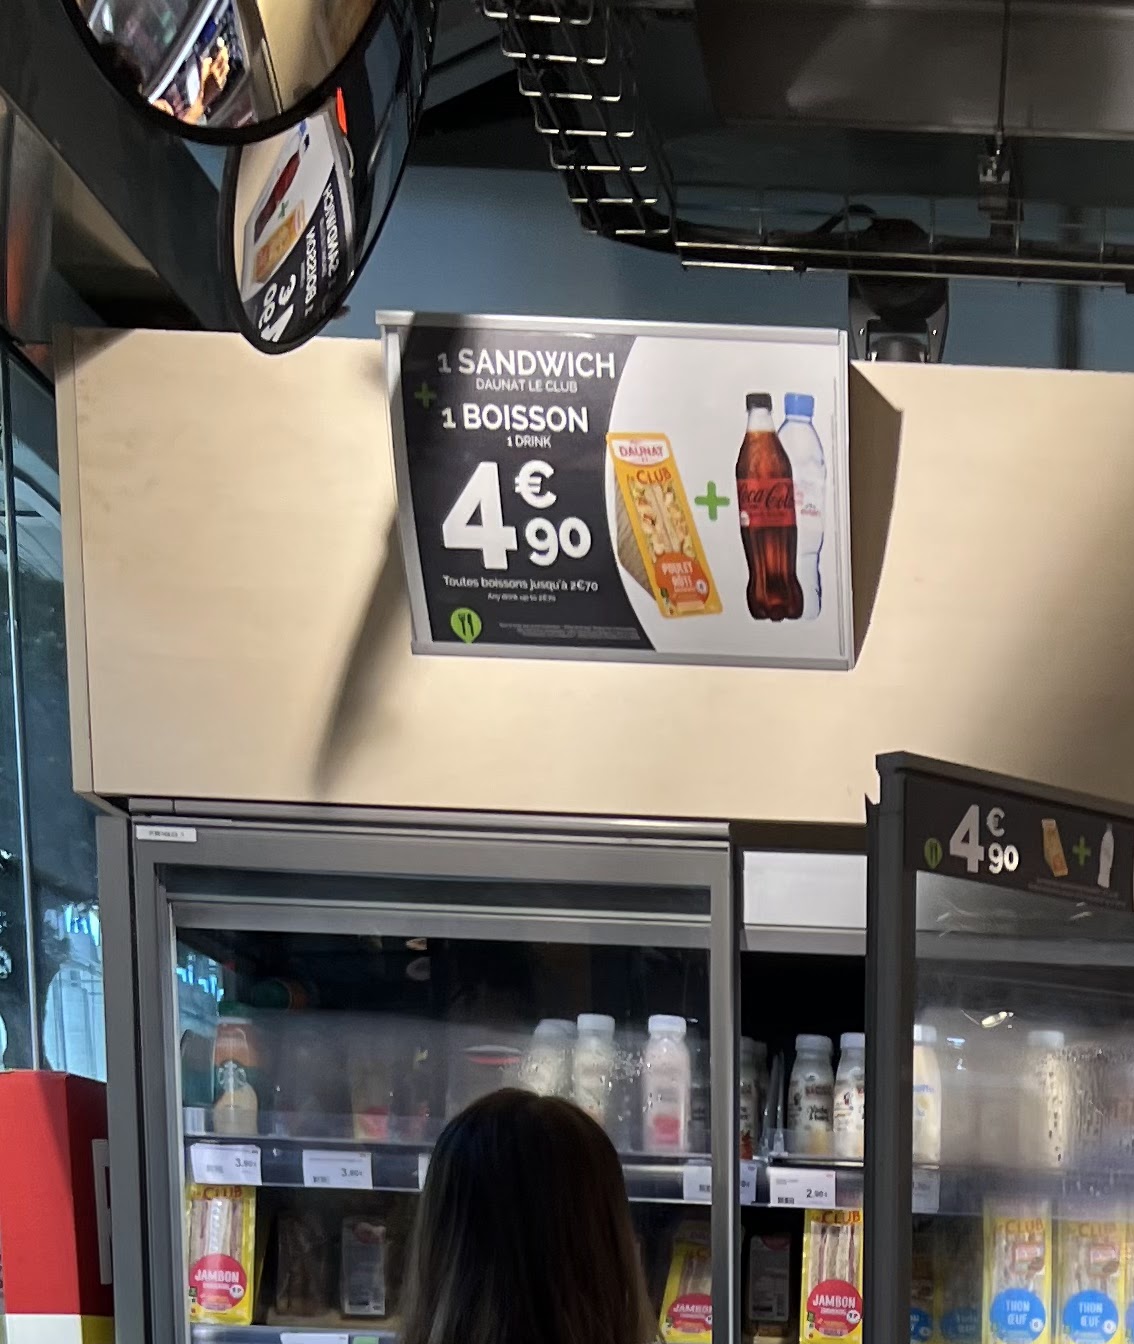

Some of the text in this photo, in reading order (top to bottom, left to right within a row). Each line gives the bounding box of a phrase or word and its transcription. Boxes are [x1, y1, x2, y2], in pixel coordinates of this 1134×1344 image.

[437, 349, 616, 379] 1 SANDWICH
[475, 378, 578, 393] DAUNAT LE CLUB
[441, 402, 589, 433] 1 BOISSON
[506, 435, 551, 448] 1 DRINK
[618, 445, 663, 458] DAUNAT
[636, 469, 672, 485] CLUB
[443, 574, 480, 588] Toutes
[481, 576, 528, 590] boissons
[530, 578, 569, 592] jusqu'à
[820, 1210, 860, 1224] CLUB
[1006, 1219, 1044, 1235] CLUB
[195, 1269, 240, 1284] JAMBON
[812, 1294, 857, 1308] JAMBON
[1006, 1300, 1030, 1312] THON
[1079, 1302, 1103, 1314] THON
